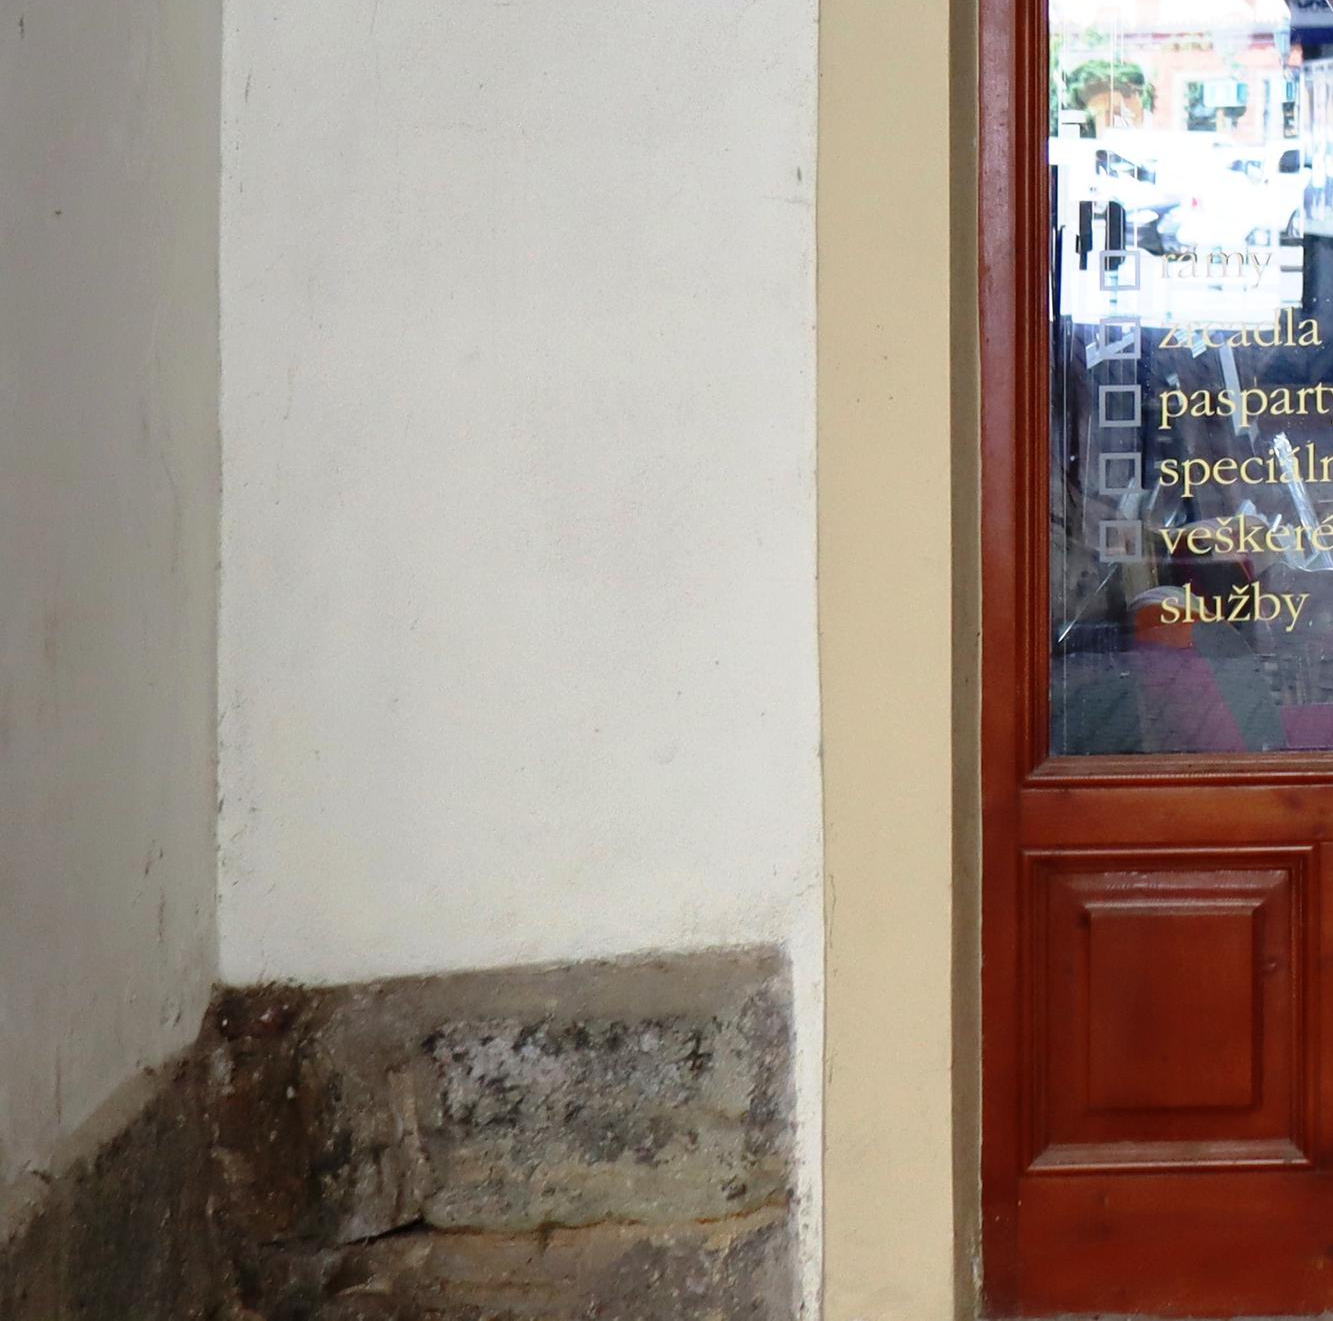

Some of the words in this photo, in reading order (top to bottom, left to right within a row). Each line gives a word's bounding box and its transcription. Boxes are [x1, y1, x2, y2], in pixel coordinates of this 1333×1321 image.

[1161, 244, 1273, 288] rámy
[1158, 305, 1323, 349] zrcadla
[1160, 582, 1309, 632] služby
